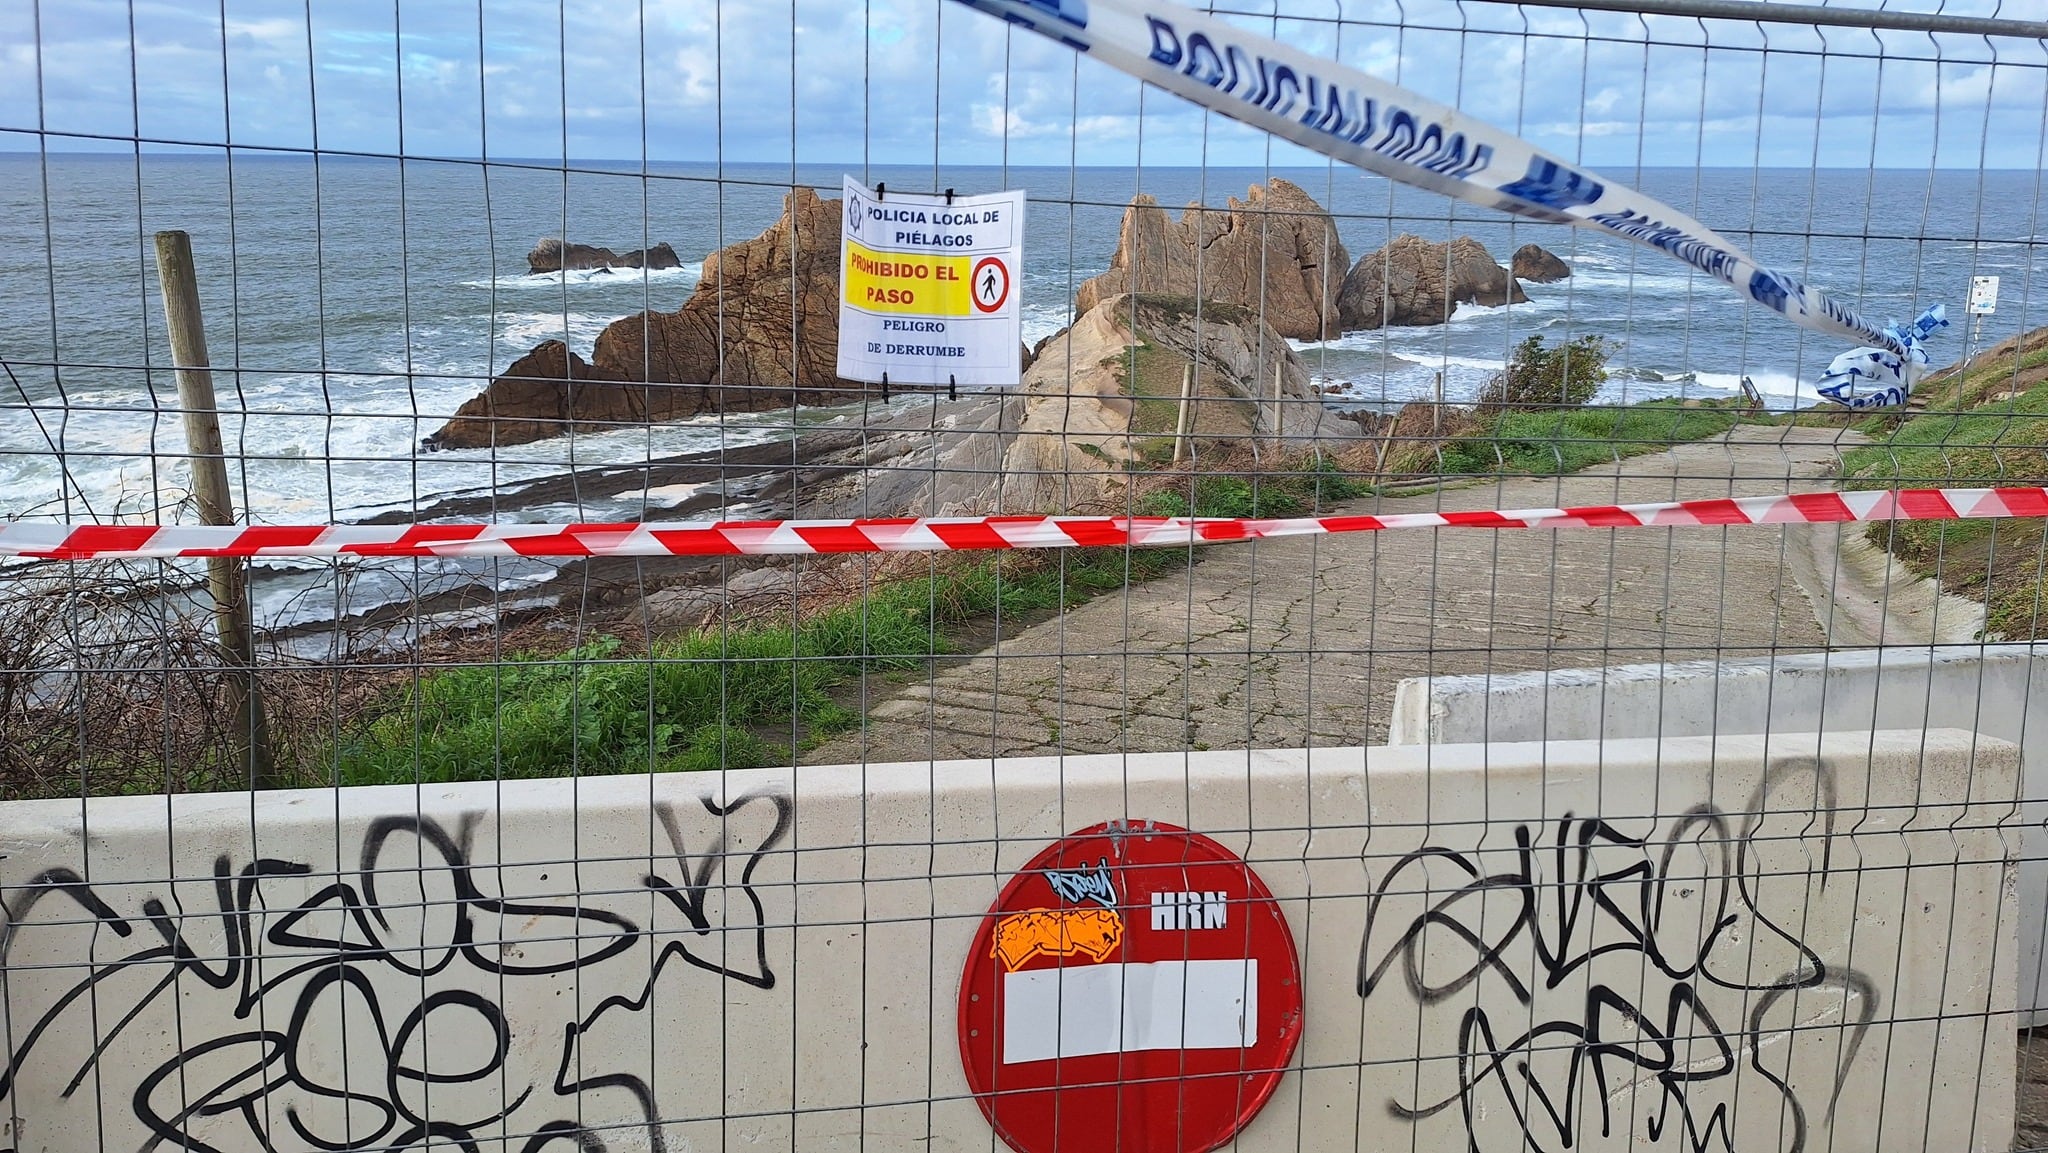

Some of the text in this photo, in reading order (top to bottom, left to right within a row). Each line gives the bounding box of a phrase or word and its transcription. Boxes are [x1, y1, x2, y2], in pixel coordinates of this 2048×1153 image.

[868, 206, 999, 226] POLICIA LOCAL DE
[896, 230, 973, 247] PIÉLAGOS
[851, 252, 960, 281] PROHIBIDO EL
[867, 287, 914, 305] PASO
[883, 320, 945, 333] PELIGRO
[867, 342, 966, 357] DE DERRUMBE
